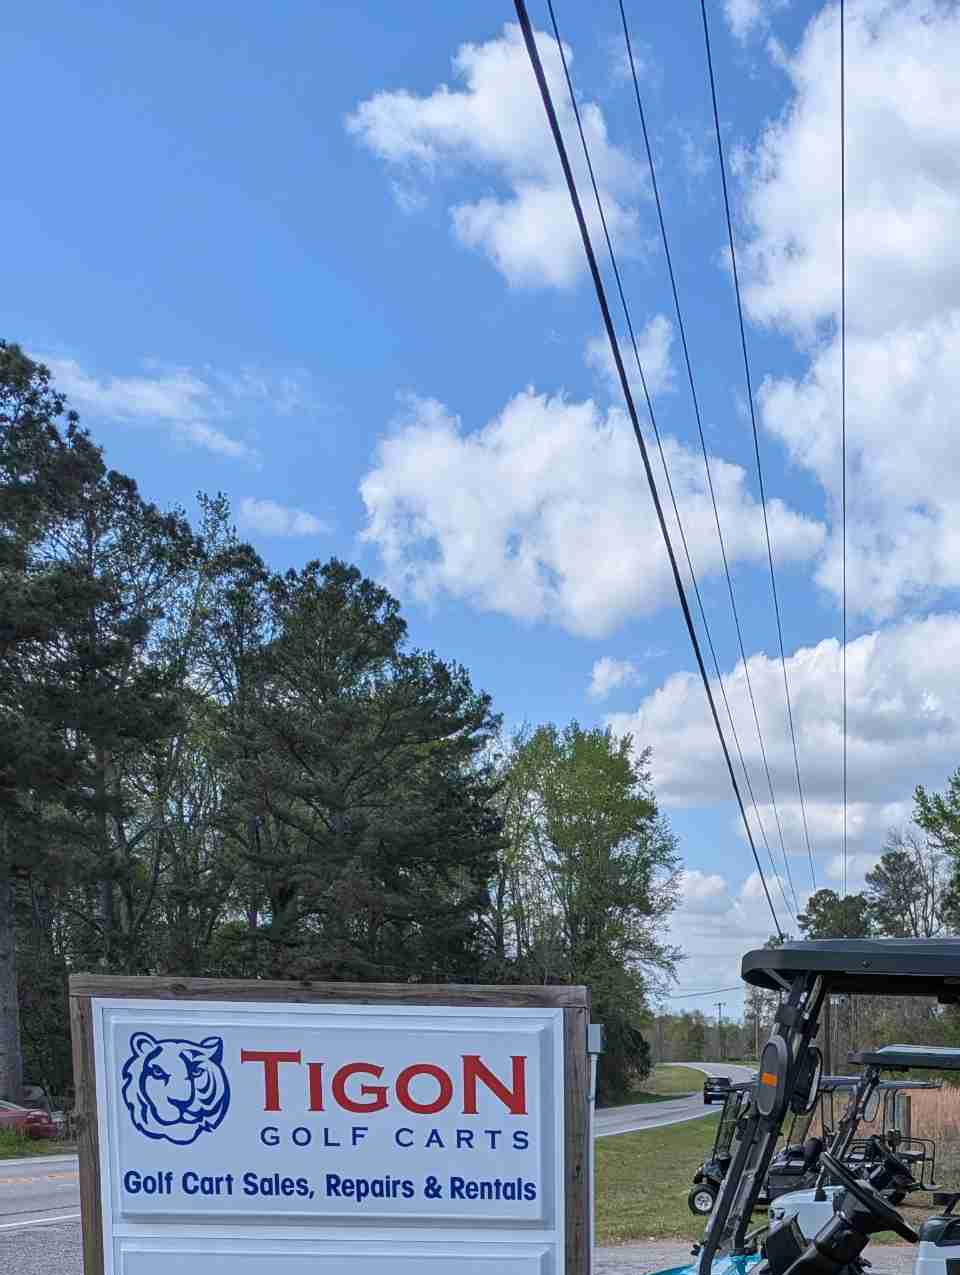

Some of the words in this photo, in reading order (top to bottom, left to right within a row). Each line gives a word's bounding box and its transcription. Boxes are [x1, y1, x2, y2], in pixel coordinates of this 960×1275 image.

[240, 1048, 528, 1115] TIGON
[260, 1126, 368, 1147] GOLF
[394, 1128, 529, 1150] CARTS
[123, 1170, 173, 1195] Golf
[181, 1172, 234, 1196] Cart
[242, 1172, 315, 1199] Sales,
[326, 1173, 414, 1202] Repairs
[424, 1177, 443, 1199] &
[450, 1176, 537, 1201] Rentals
